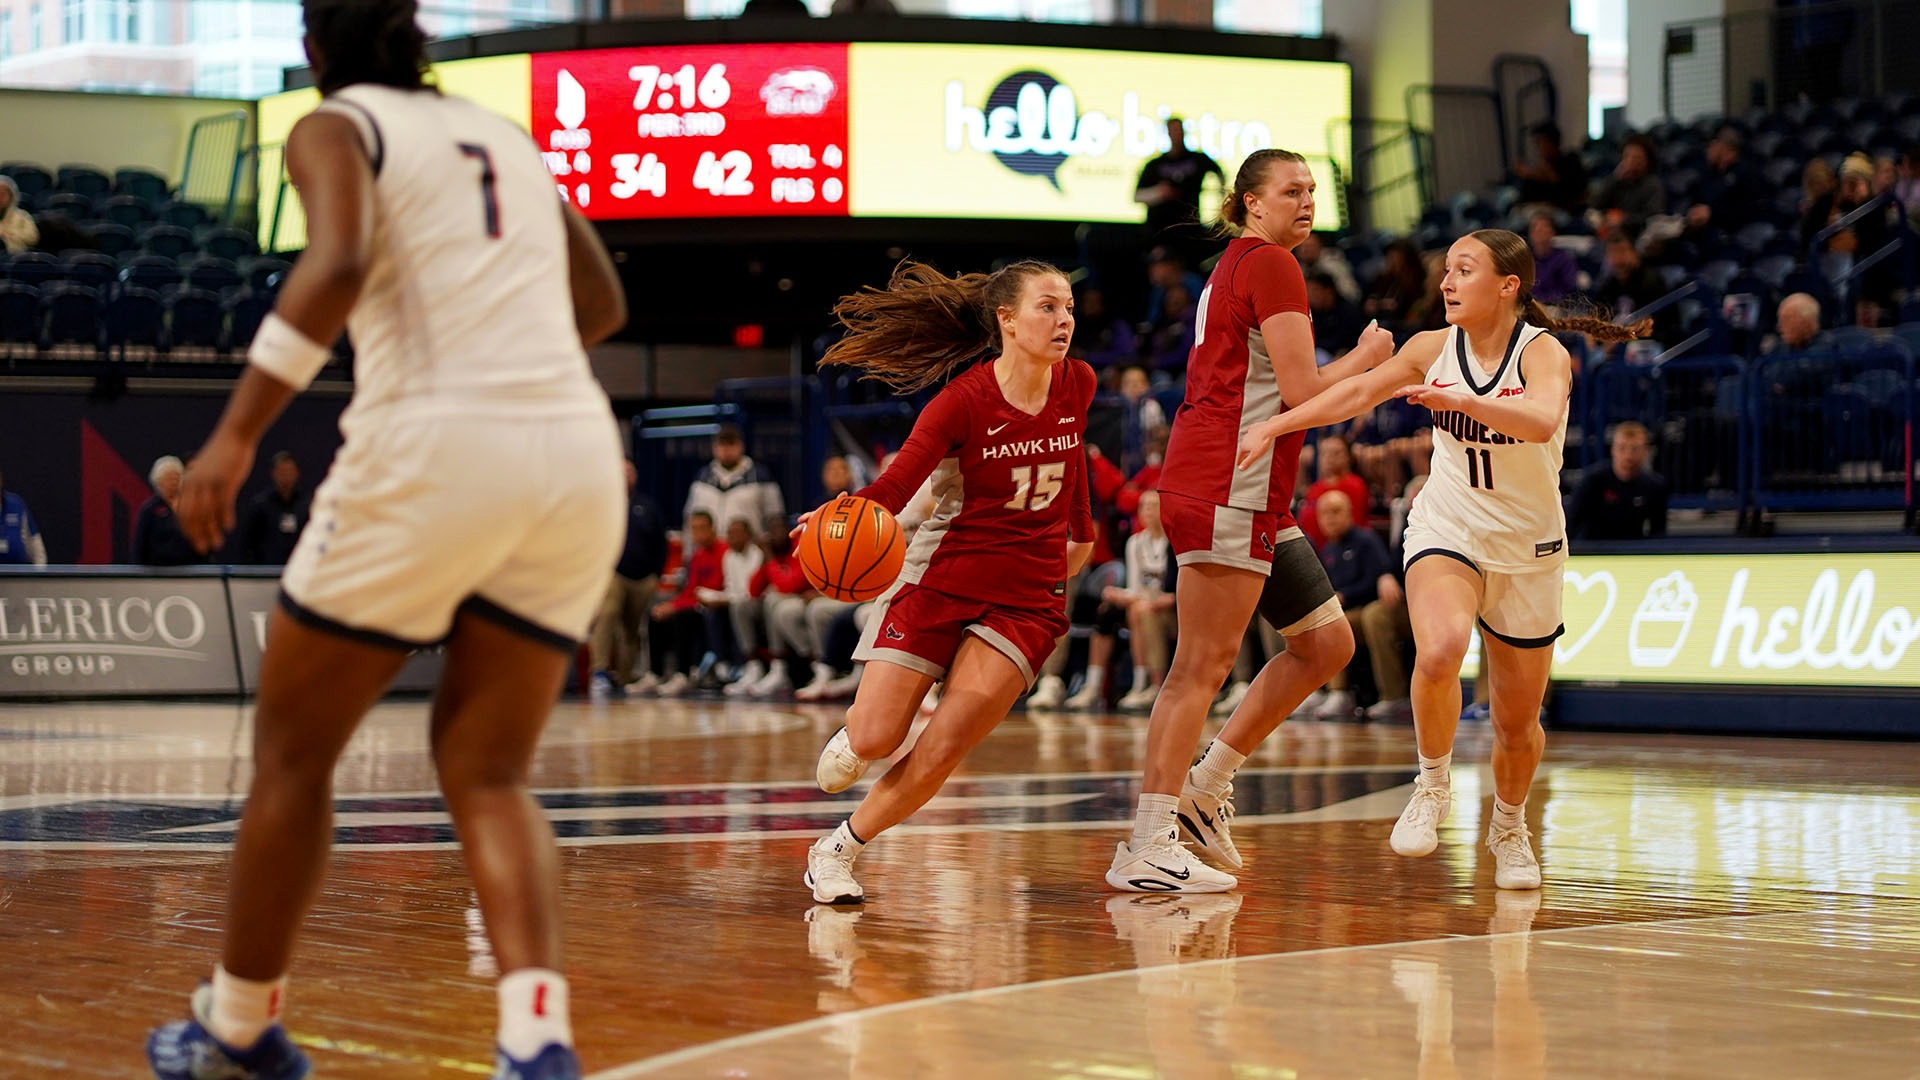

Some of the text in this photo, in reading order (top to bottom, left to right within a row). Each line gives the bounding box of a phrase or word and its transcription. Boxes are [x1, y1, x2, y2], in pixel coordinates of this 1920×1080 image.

[629, 64, 731, 110] 7:16
[945, 80, 1120, 156] hello
[610, 153, 667, 199] 34
[692, 149, 754, 196] 42
[982, 432, 1080, 460] HAWK HILL
[1465, 447, 1494, 490] 11
[1004, 462, 1066, 512] 15
[1710, 567, 1920, 671] hello
[11, 655, 116, 676] GROUP
